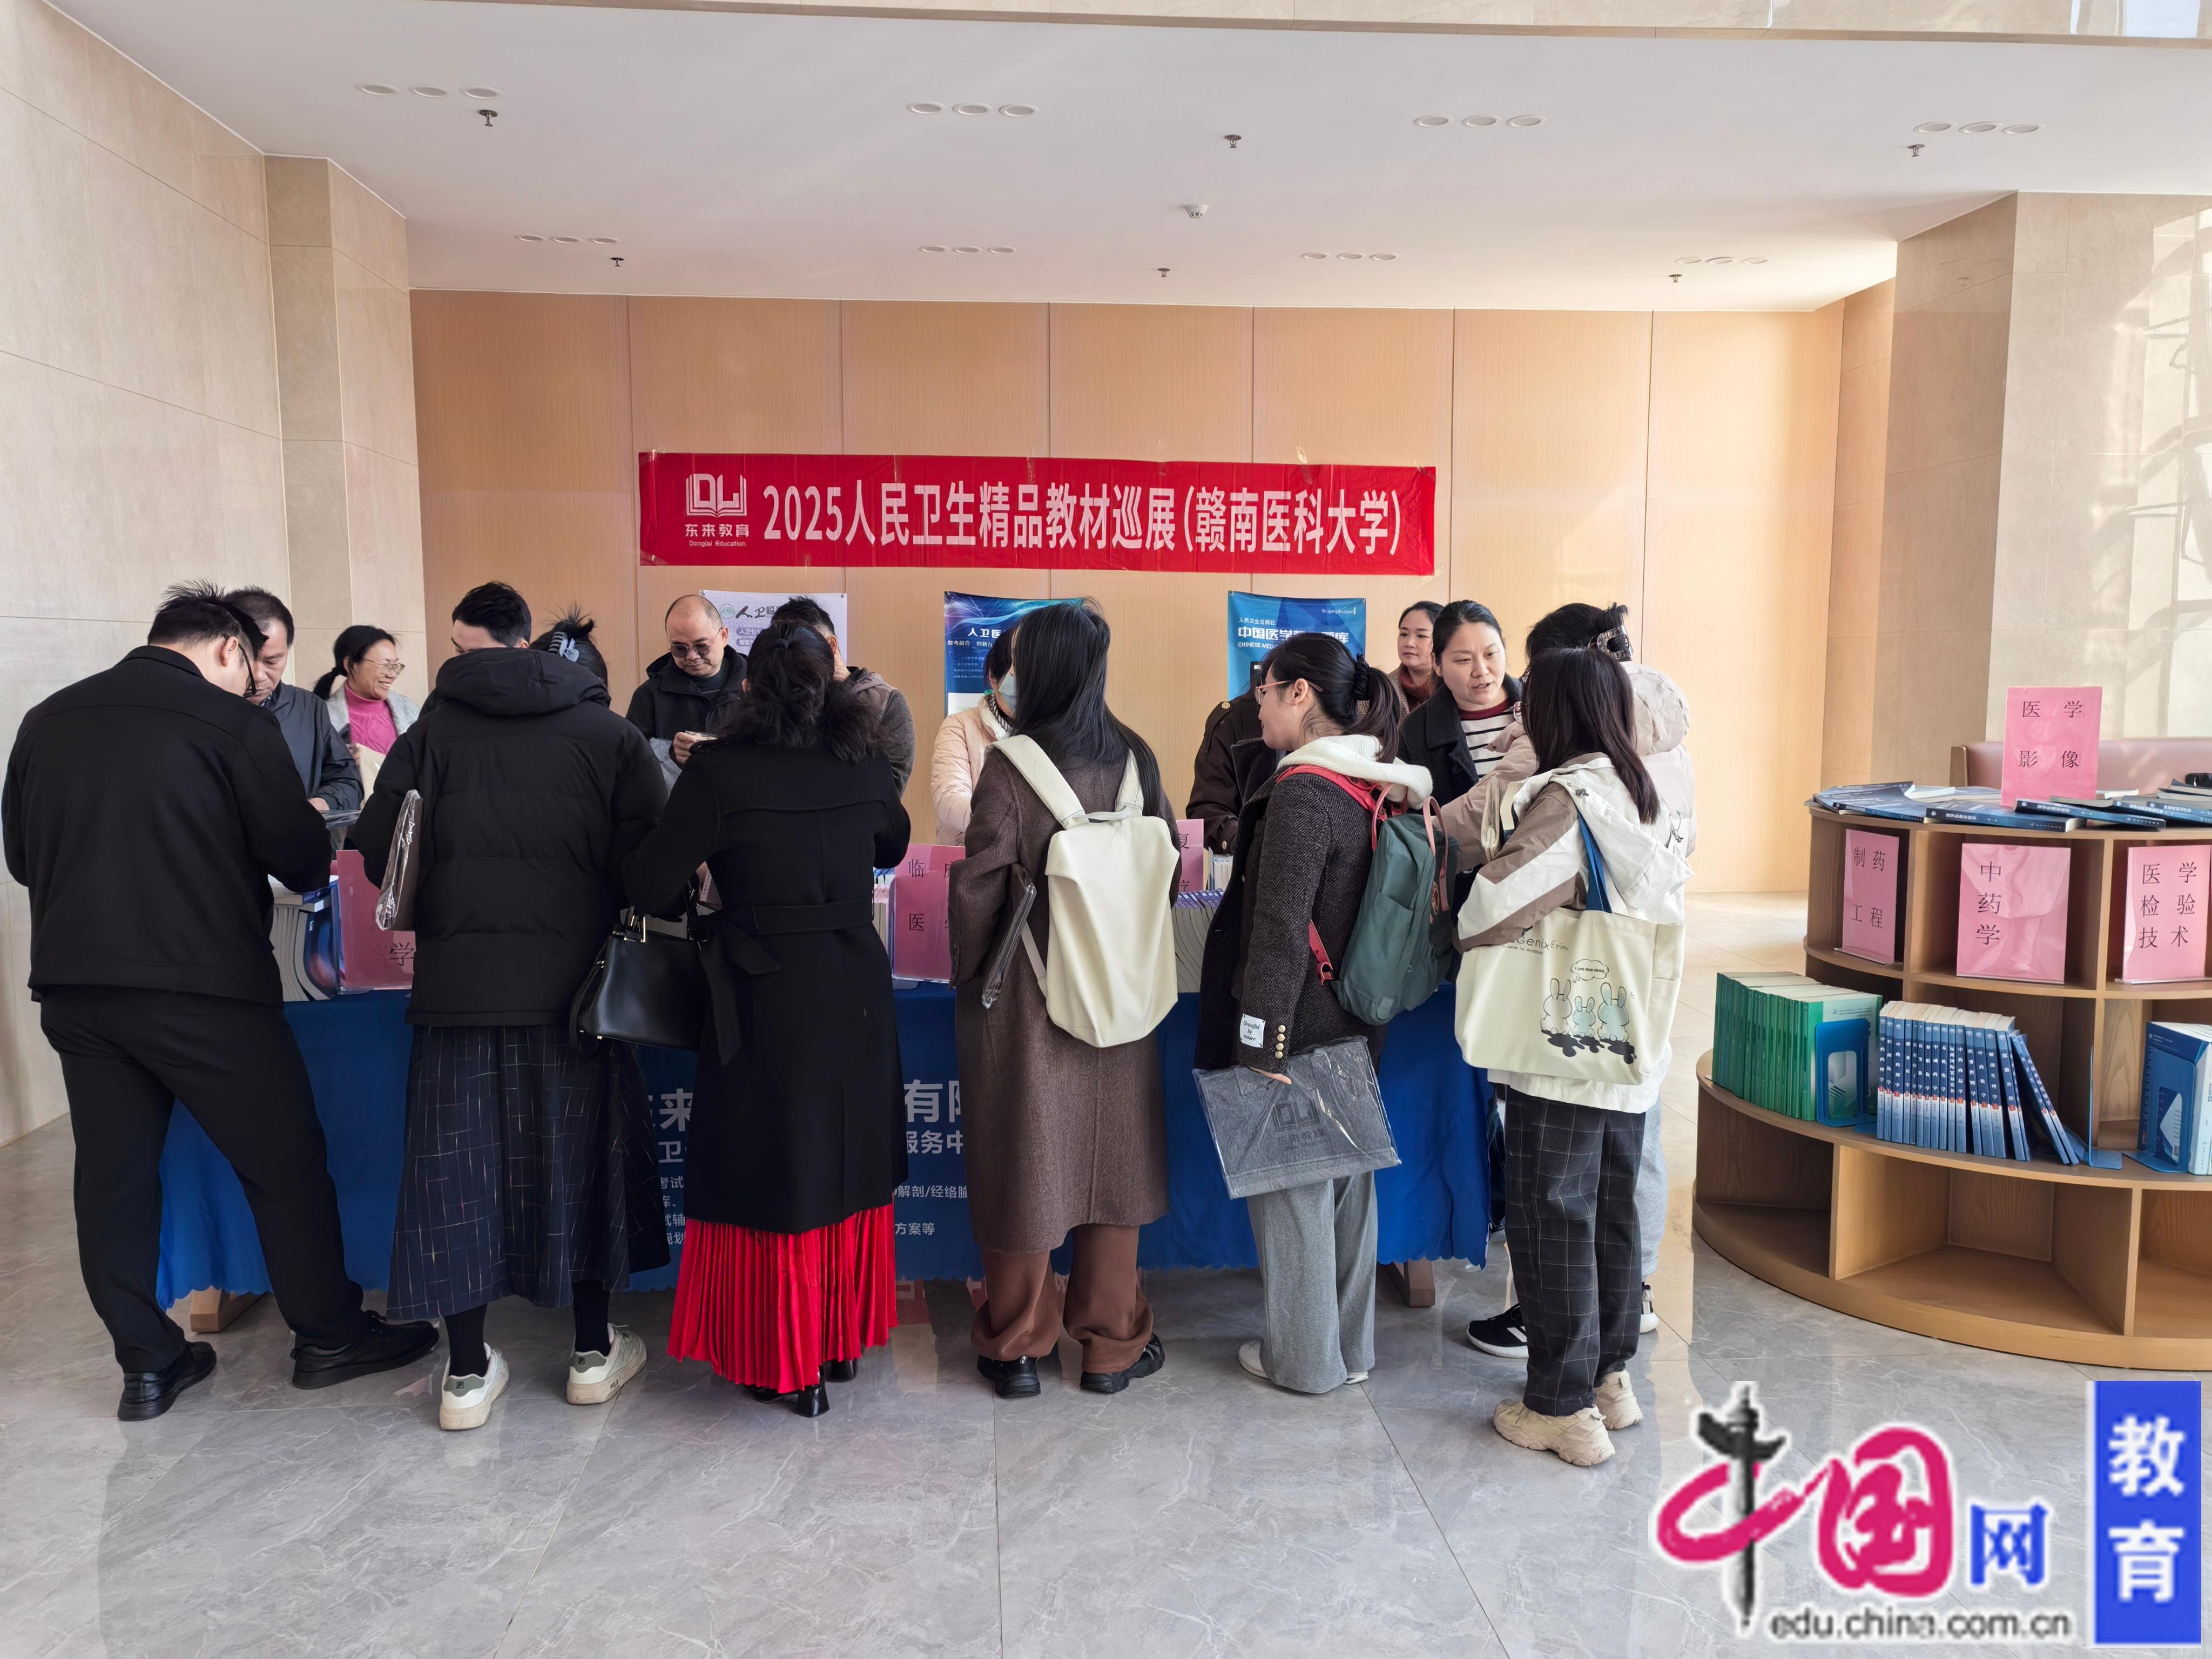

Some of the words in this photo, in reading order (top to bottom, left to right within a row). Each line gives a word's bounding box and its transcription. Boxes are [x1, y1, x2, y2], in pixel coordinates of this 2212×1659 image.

[685, 523, 750, 537] 东来教育
[1239, 617, 1276, 625] 人民卫生出版社
[2022, 700, 2083, 719] 医学
[2019, 749, 2080, 769] 影像
[1853, 846, 1886, 872] 制药
[2142, 862, 2197, 886] 医学
[1975, 860, 2003, 946] 中药学
[2140, 893, 2196, 918] 检验
[1851, 903, 1884, 929] 工程
[2139, 925, 2189, 949] 技术
[1243, 1020, 1260, 1030] Graceful
[649, 1088, 693, 1132] 来
[894, 1222, 935, 1236] 方案等
